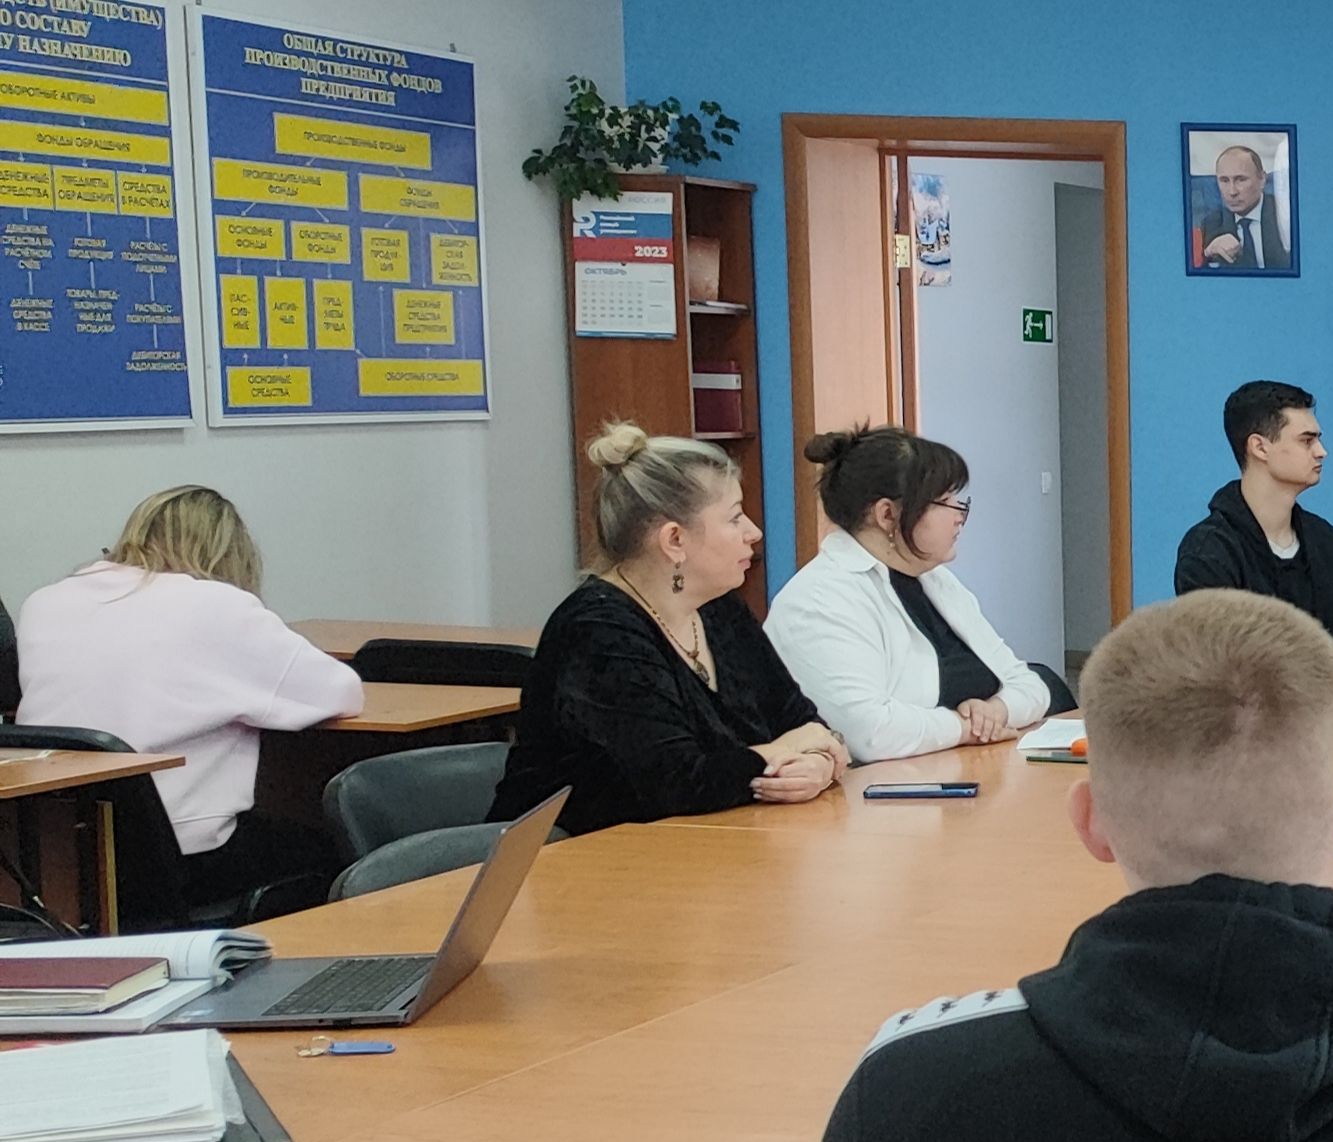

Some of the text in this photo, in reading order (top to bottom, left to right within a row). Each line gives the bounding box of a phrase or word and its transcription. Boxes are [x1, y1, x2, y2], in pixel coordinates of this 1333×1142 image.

[15, 11, 91, 38] СОСТАВУ
[17, 35, 132, 67] НАЗНАЧЕНИЮ
[283, 33, 409, 68] ОБЩАЯ СТРУКТУРА
[244, 47, 443, 94] ПРОИЗВОДСТВЕННЫХ ФОНДОВ
[300, 77, 396, 106] ПРЕДПРИЯТИЯ
[36, 132, 131, 152] ФОНДЫ ОБРАЩЕНИЯ
[228, 224, 273, 237] ОСНОВНЫЕ
[236, 239, 267, 249] ФОНДЫ
[634, 245, 668, 258] 2023
[584, 267, 627, 276] ОКТЯБРЬ
[248, 374, 292, 385] ОСНОВНЫЕ
[251, 387, 291, 398] СРЕДСТВА
